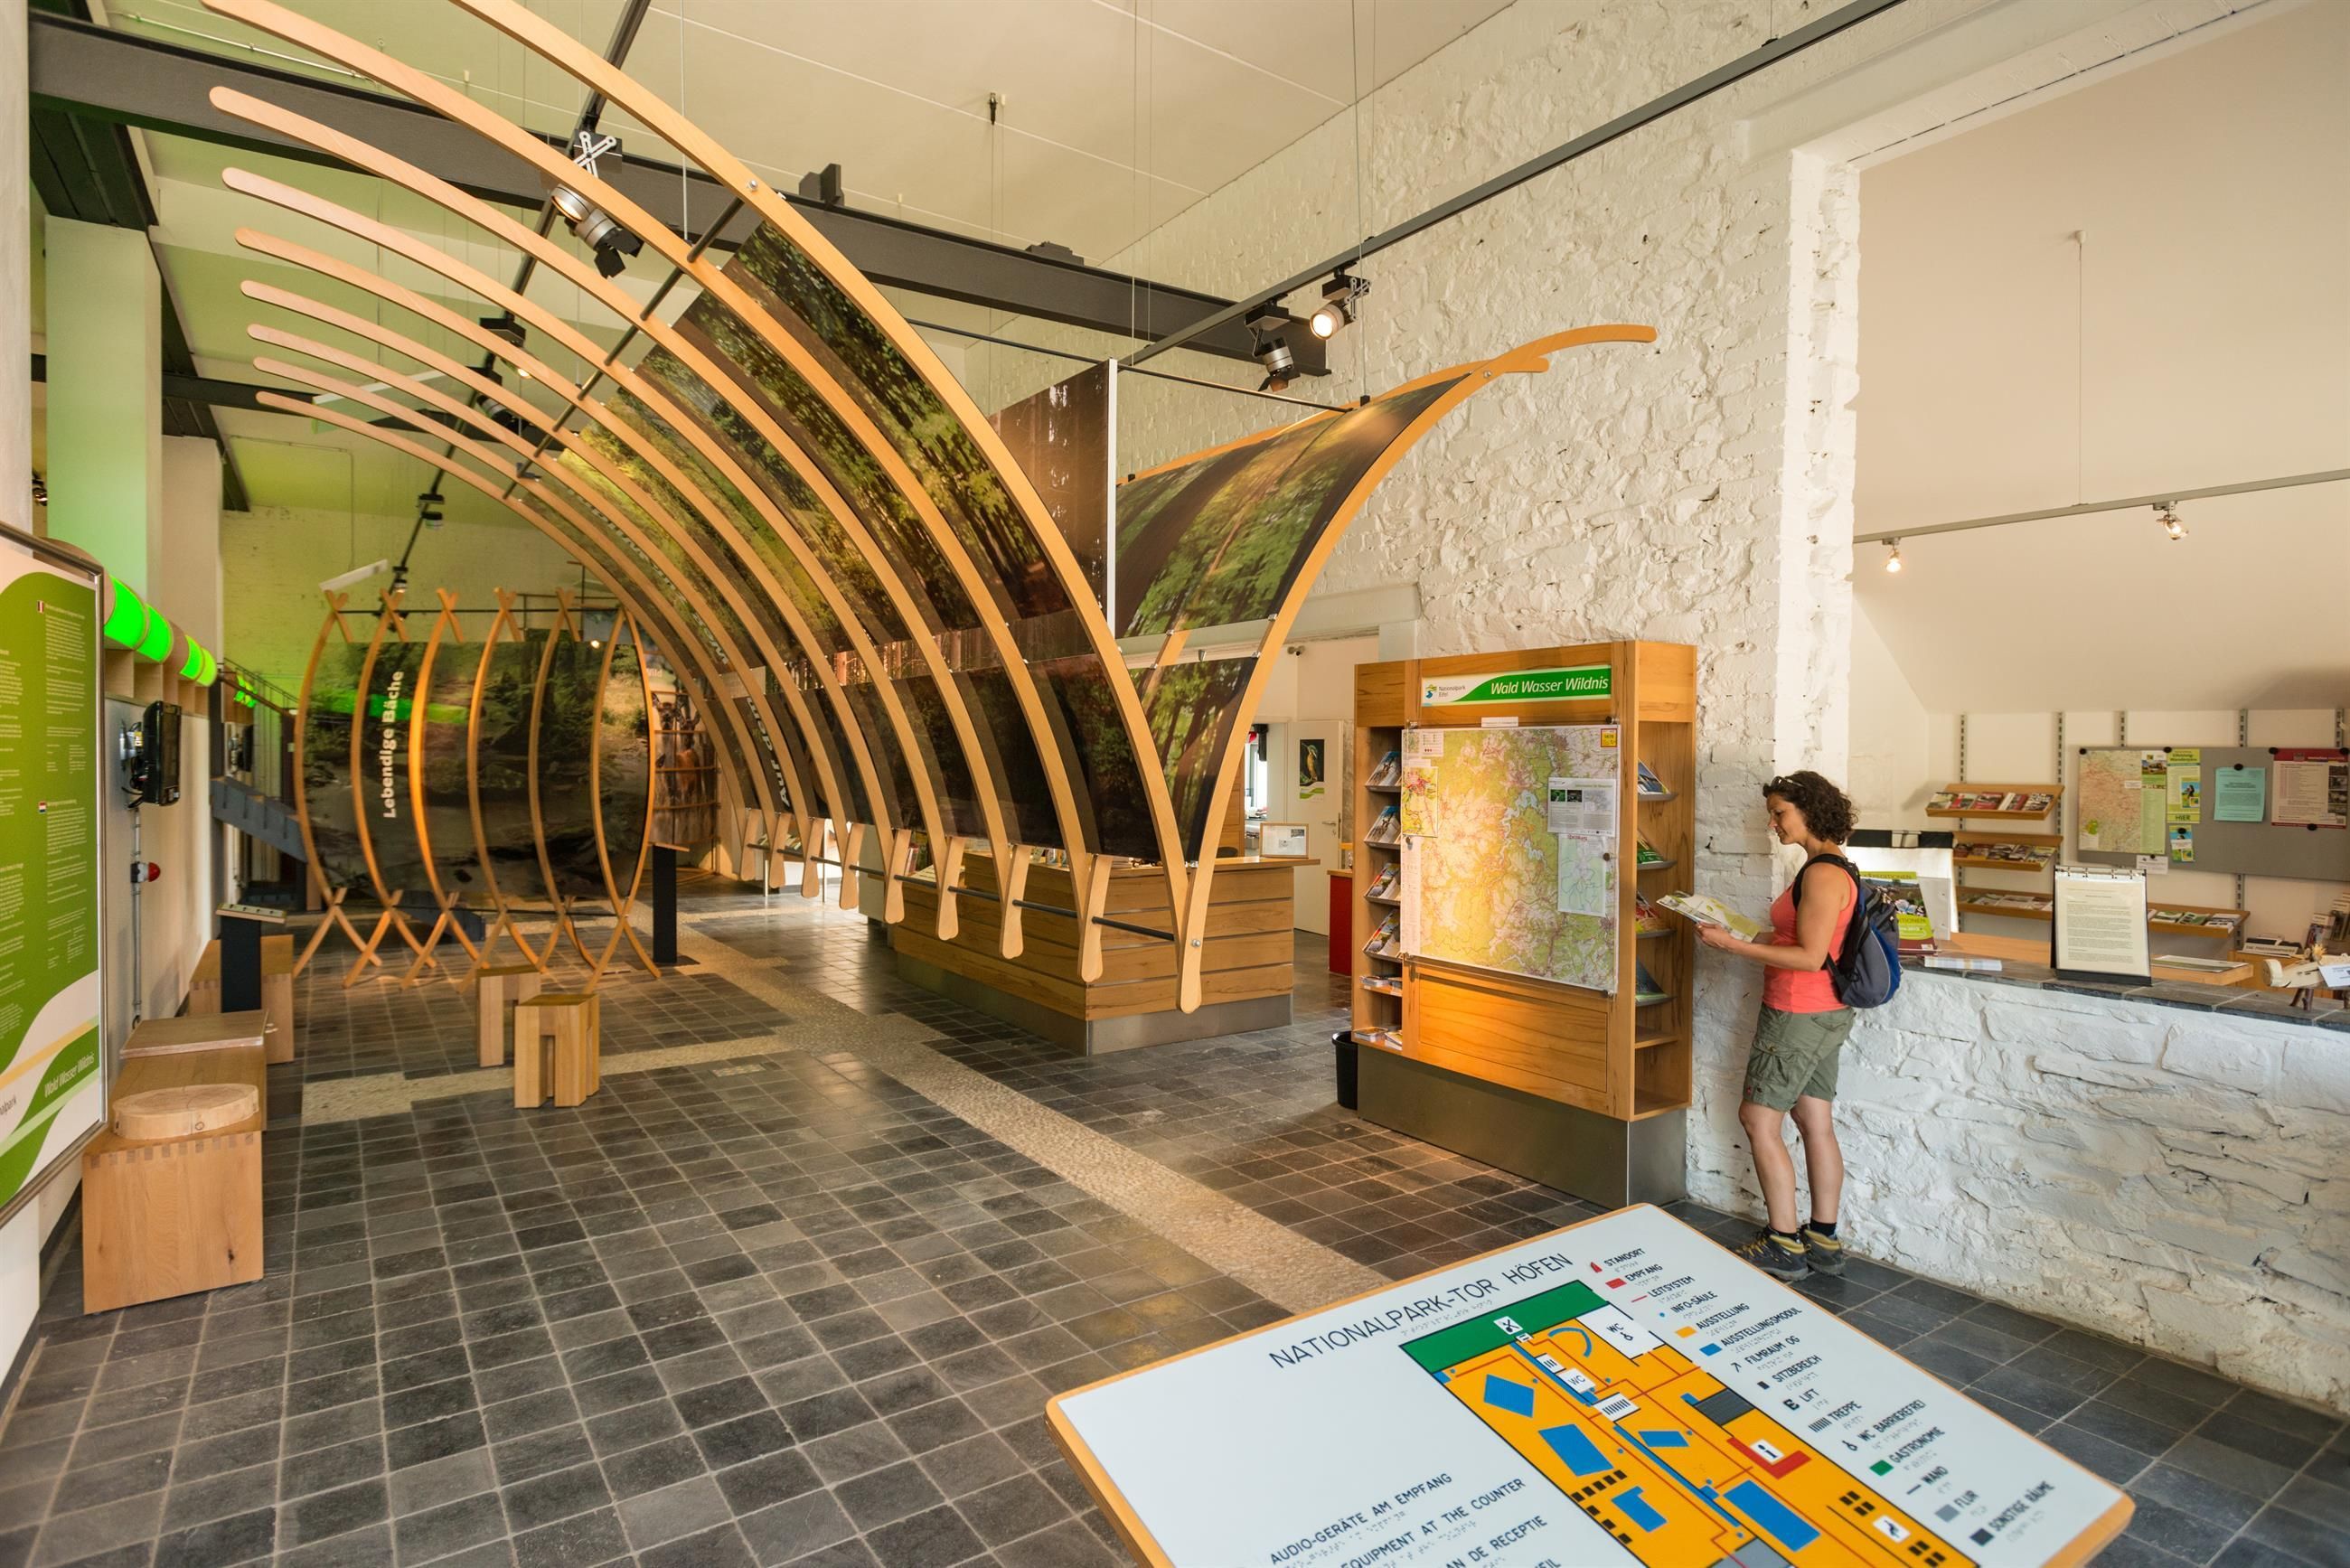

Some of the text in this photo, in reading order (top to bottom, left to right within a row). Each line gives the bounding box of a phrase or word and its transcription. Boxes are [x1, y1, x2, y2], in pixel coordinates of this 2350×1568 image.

[1491, 675, 1609, 695] Wald Wasser Wildnis
[379, 671, 405, 818] Lebendige Bäche
[45, 1051, 95, 1098] Wald Wasser Wildnis
[1603, 1247, 1646, 1267] STANDORT
[1624, 1263, 1663, 1282] EMPFANG
[1647, 1275, 1696, 1299] LEITSYSTEM
[1268, 1253, 1574, 1369] NATIONALPARK-TOR HÖFEN
[1670, 1291, 1718, 1314] INFO-SÄULE
[1696, 1302, 1751, 1330] AUSSTELLUNG
[1606, 1323, 1624, 1333] WC
[1720, 1307, 1802, 1347] AUSSTELLUNGSMODUL
[1744, 1335, 1800, 1366] FILMRAUM OG
[1568, 1375, 1585, 1385] WC
[1772, 1355, 1823, 1383] SITZBEREICH
[1799, 1388, 1820, 1403] LIFT
[1828, 1401, 1863, 1422] TREPPE
[1856, 1399, 1927, 1442] WC BARRIEREFREI
[1888, 1426, 1946, 1464] GASTRONOMIE
[1921, 1465, 1950, 1486] WAND
[1953, 1489, 1979, 1509] FLUR
[1988, 1479, 2056, 1533] SONSTIGE RÄUME
[1270, 1473, 1453, 1565] AUDIO-GERÄTE AM EMPFANG
[1340, 1478, 1526, 1568] EQUIPMENT AT THE COUNTER
[1468, 1546, 1490, 1563] DE
[1489, 1515, 1548, 1552] RECEPTIE
